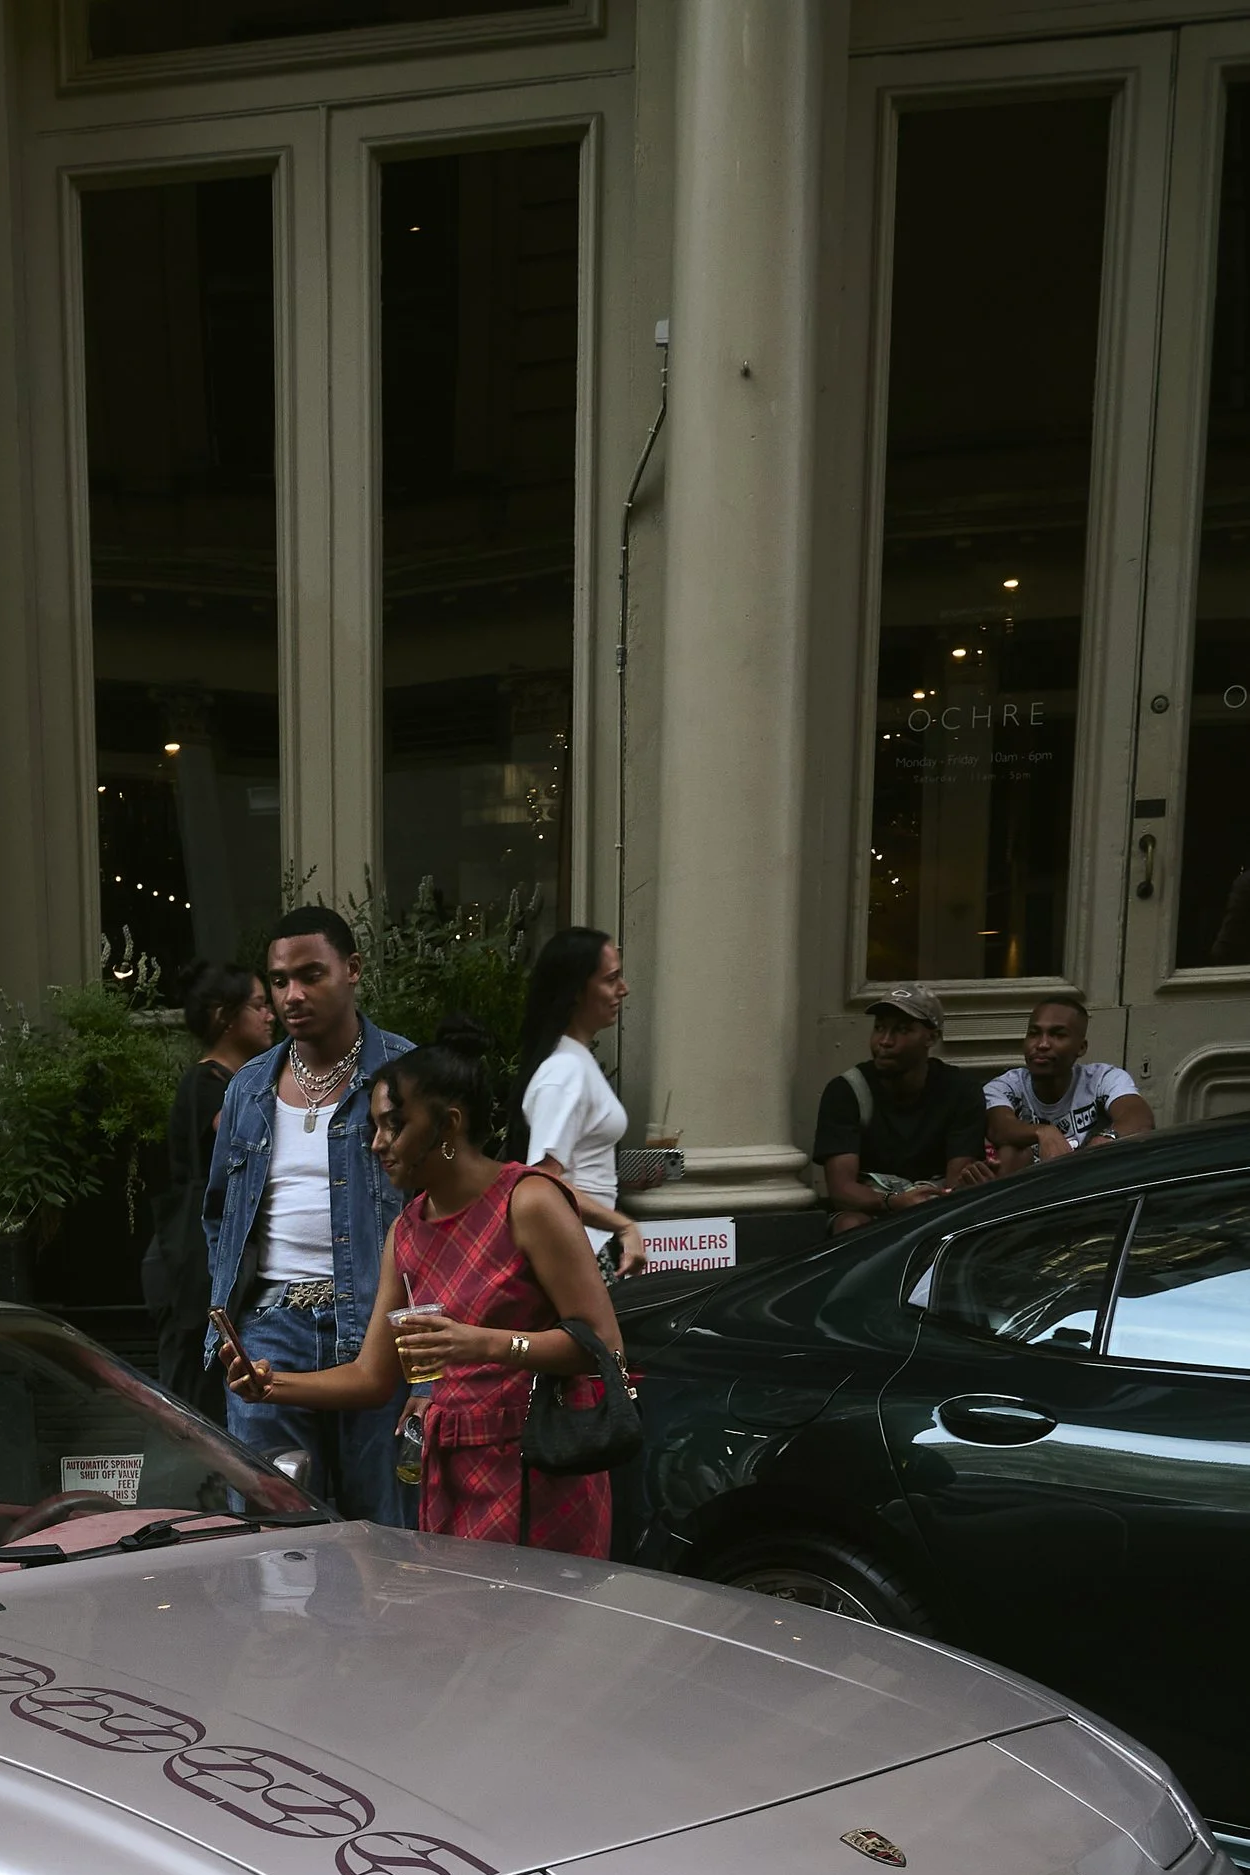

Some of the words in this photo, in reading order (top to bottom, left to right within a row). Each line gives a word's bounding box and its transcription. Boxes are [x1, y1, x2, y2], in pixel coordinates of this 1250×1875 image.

[907, 701, 1045, 732] OCHRE
[895, 756, 937, 769] Monday
[947, 753, 979, 768] Friday
[990, 751, 1018, 763] 10am
[1028, 749, 1053, 762] 6pm
[642, 1233, 728, 1253] PRINKLERS
[643, 1256, 730, 1274] HROUGHOUT
[66, 1460, 109, 1470] AUTOMATIC
[80, 1471, 99, 1480] SHUT
[102, 1470, 116, 1479] OFF
[118, 1470, 139, 1479] VALVE
[118, 1480, 136, 1489] FEET
[112, 1490, 129, 1499] THIS
